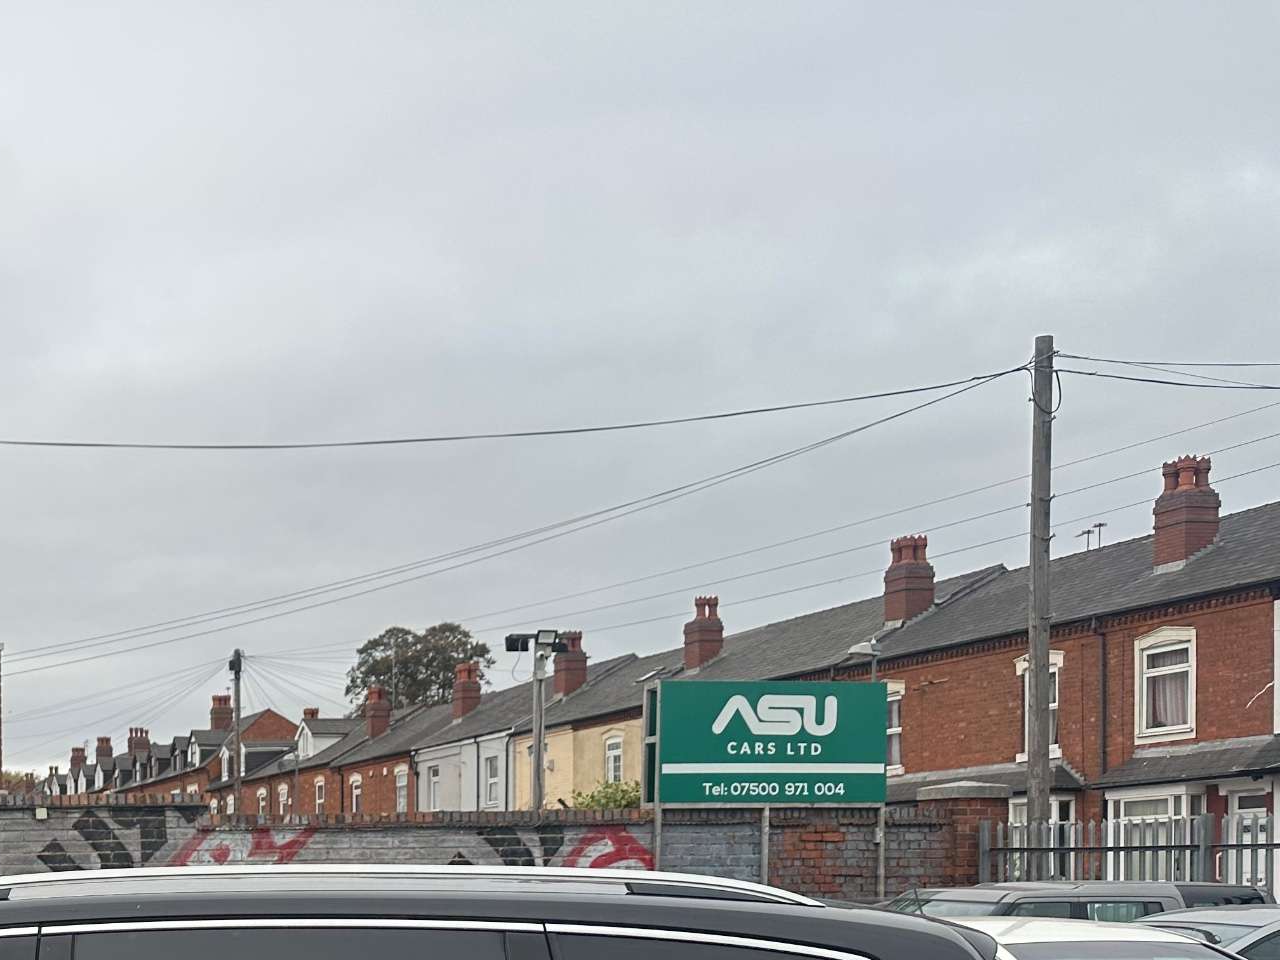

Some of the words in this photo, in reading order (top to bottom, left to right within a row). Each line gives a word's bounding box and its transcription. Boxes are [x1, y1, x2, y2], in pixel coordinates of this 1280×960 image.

[712, 695, 838, 737] ASU
[727, 742, 776, 755] CARS
[786, 743, 822, 756] LTD
[703, 783, 728, 796] Tel:
[730, 783, 779, 796] 07500
[785, 783, 809, 796] 971
[814, 783, 845, 796] 004
